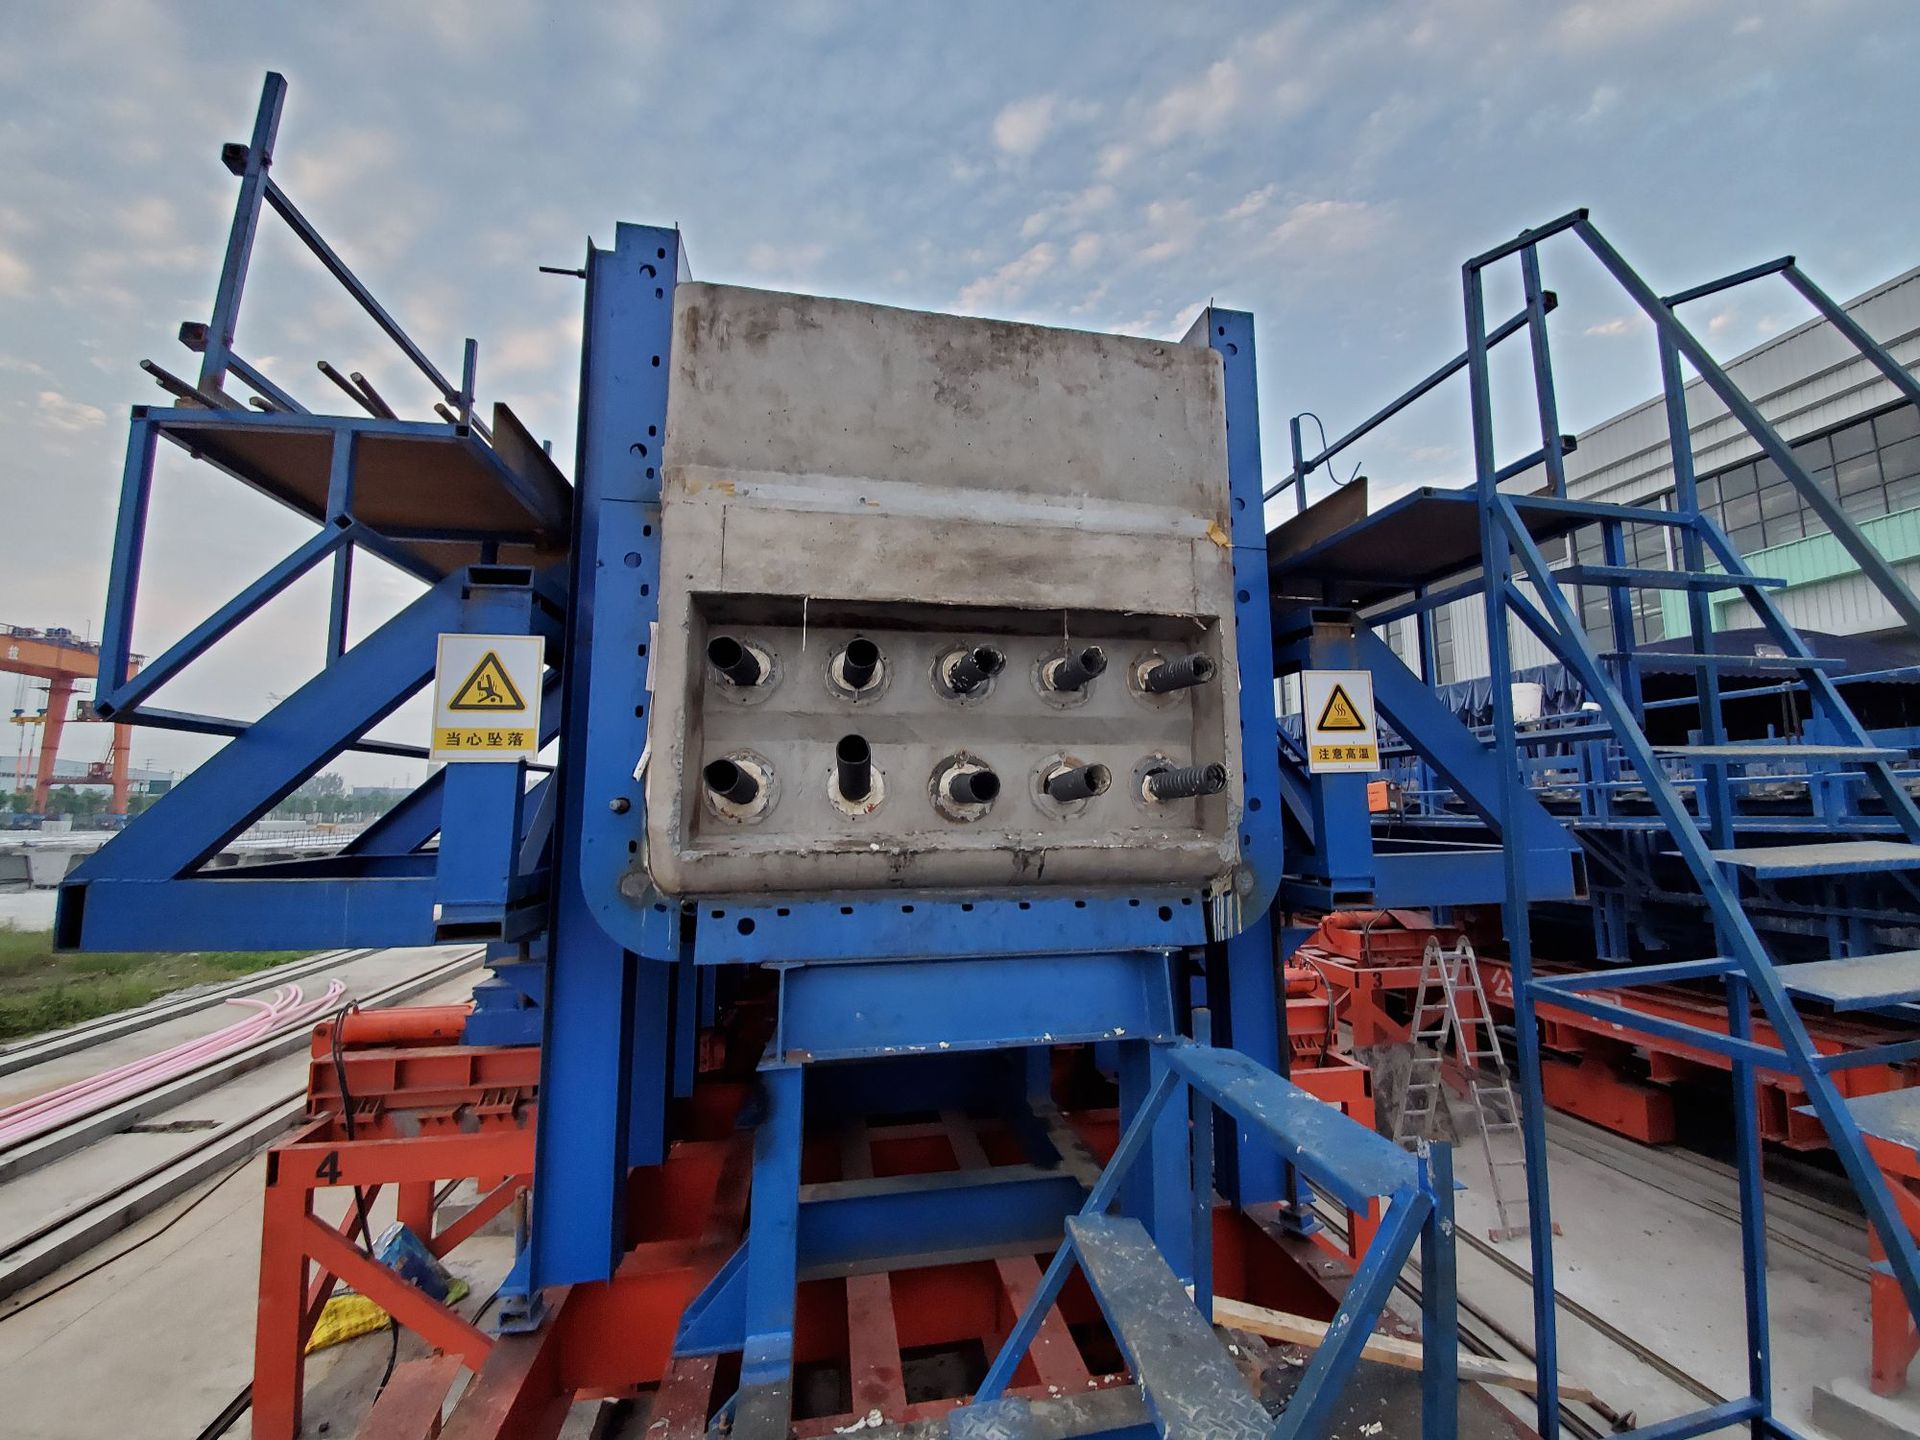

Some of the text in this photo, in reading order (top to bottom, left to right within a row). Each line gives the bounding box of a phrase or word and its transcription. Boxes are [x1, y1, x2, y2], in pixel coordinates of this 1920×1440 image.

[446, 732, 524, 747] 当心坠落
[1319, 748, 1370, 760] 注意高温
[1372, 971, 1383, 988] 3
[315, 1150, 342, 1184] 4
